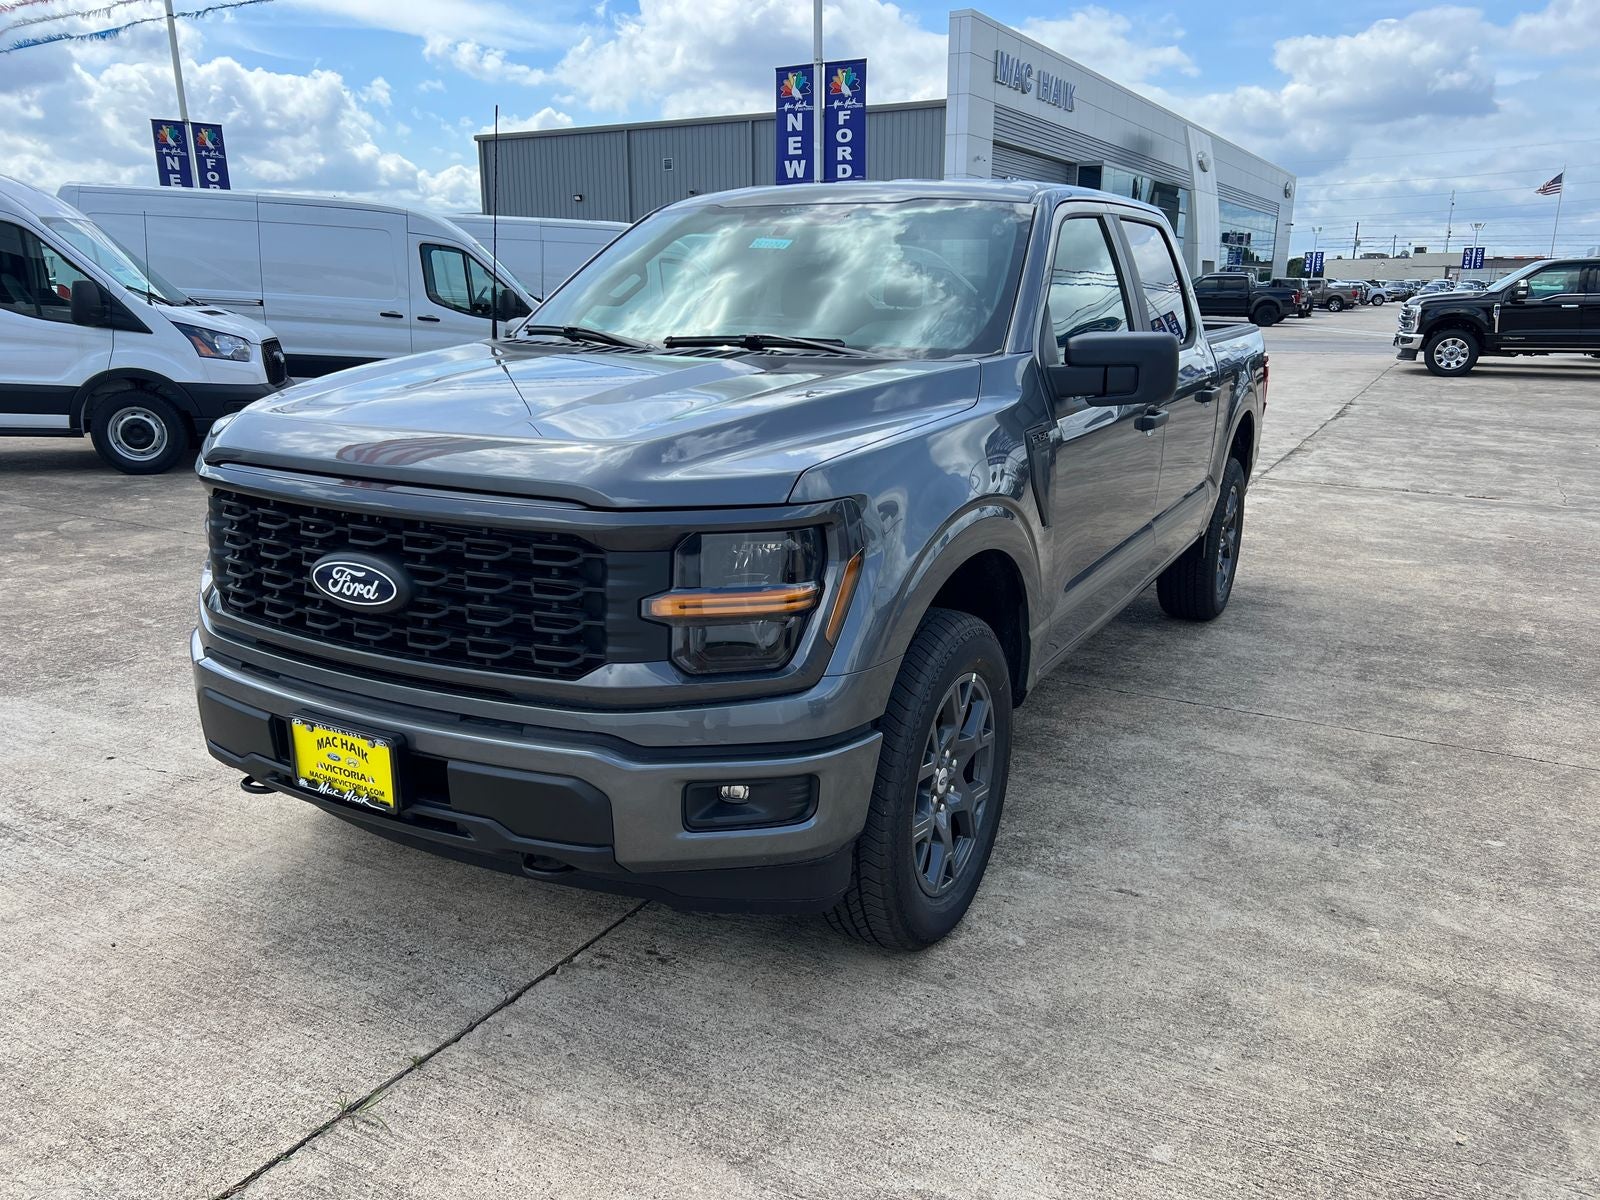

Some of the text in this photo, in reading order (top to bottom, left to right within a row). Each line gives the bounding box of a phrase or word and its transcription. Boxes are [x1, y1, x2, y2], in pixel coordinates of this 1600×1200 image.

[995, 50, 1075, 112] MAC HAIK
[784, 112, 806, 179] NEW
[835, 110, 852, 178] FORD
[165, 156, 182, 188] NE
[328, 566, 379, 600] Ford
[317, 737, 338, 750] MAC
[341, 738, 368, 763] HAIK
[323, 763, 367, 782] VICTORIA
[317, 781, 342, 799] Mac
